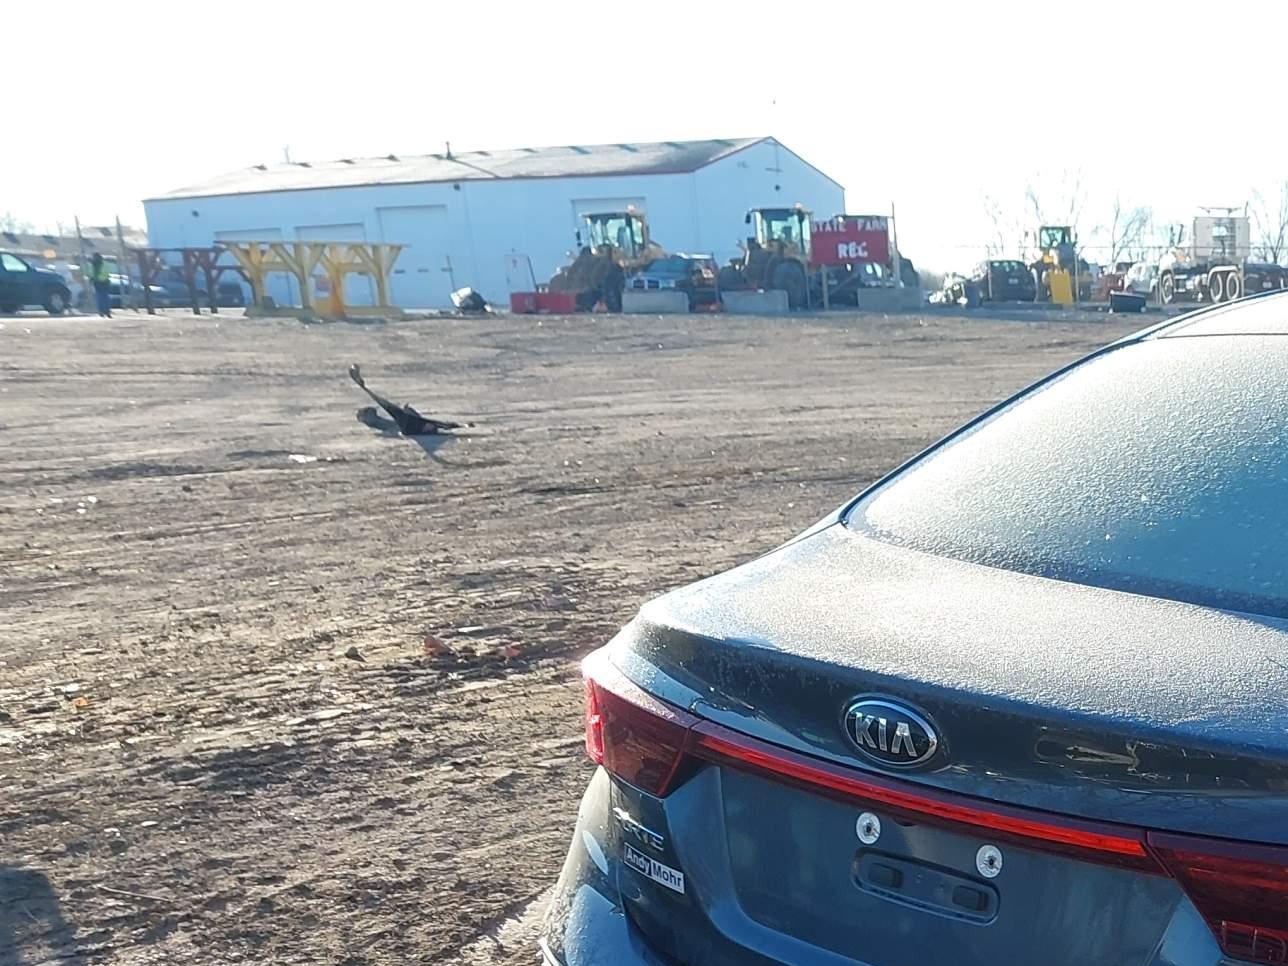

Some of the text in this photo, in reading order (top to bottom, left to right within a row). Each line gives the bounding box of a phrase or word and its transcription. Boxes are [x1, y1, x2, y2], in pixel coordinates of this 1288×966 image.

[811, 218, 847, 232] STATE
[855, 711, 918, 757] KIA
[626, 847, 683, 887] Andy Mohr
